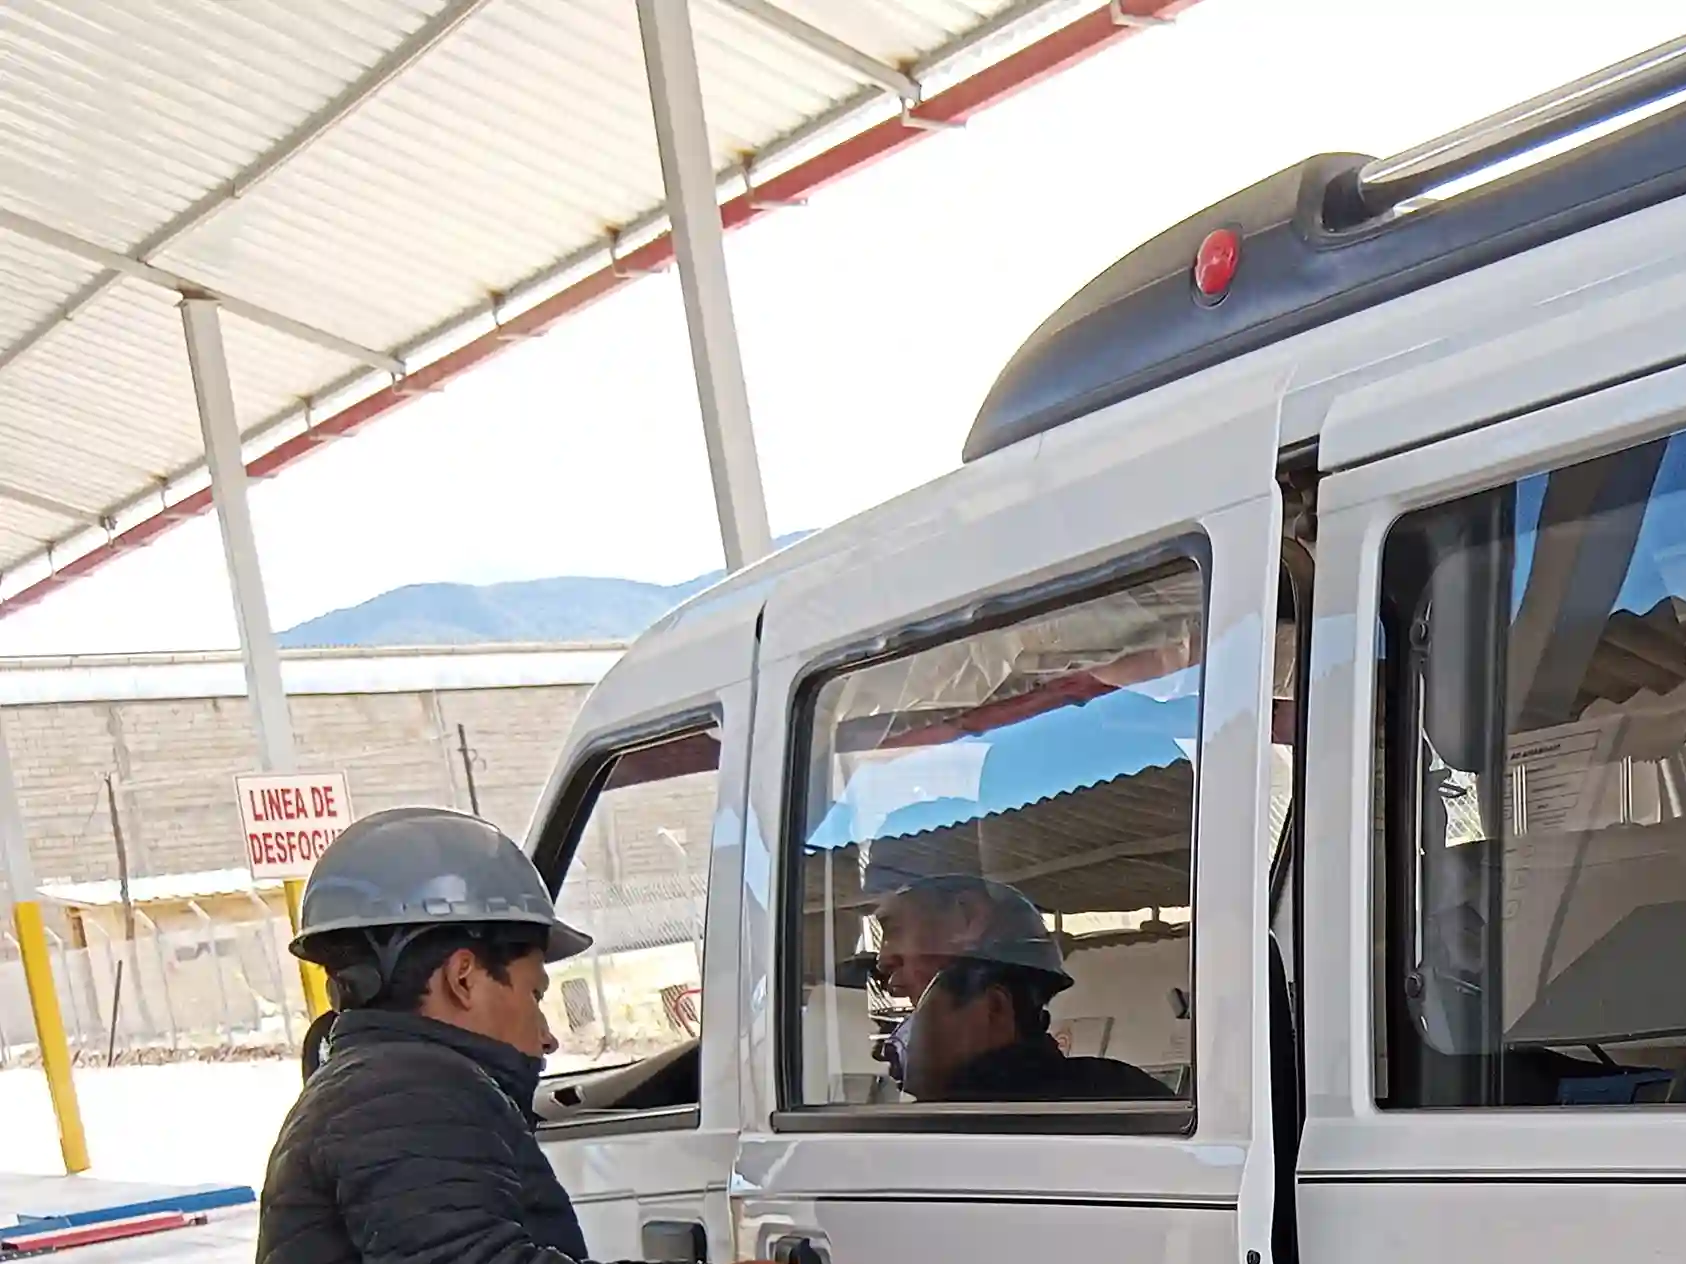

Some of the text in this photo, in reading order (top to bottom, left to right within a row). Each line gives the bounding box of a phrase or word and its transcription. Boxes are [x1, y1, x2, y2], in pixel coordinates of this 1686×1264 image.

[250, 786, 337, 821] LINEA DE
[249, 828, 343, 864] DESFOG
